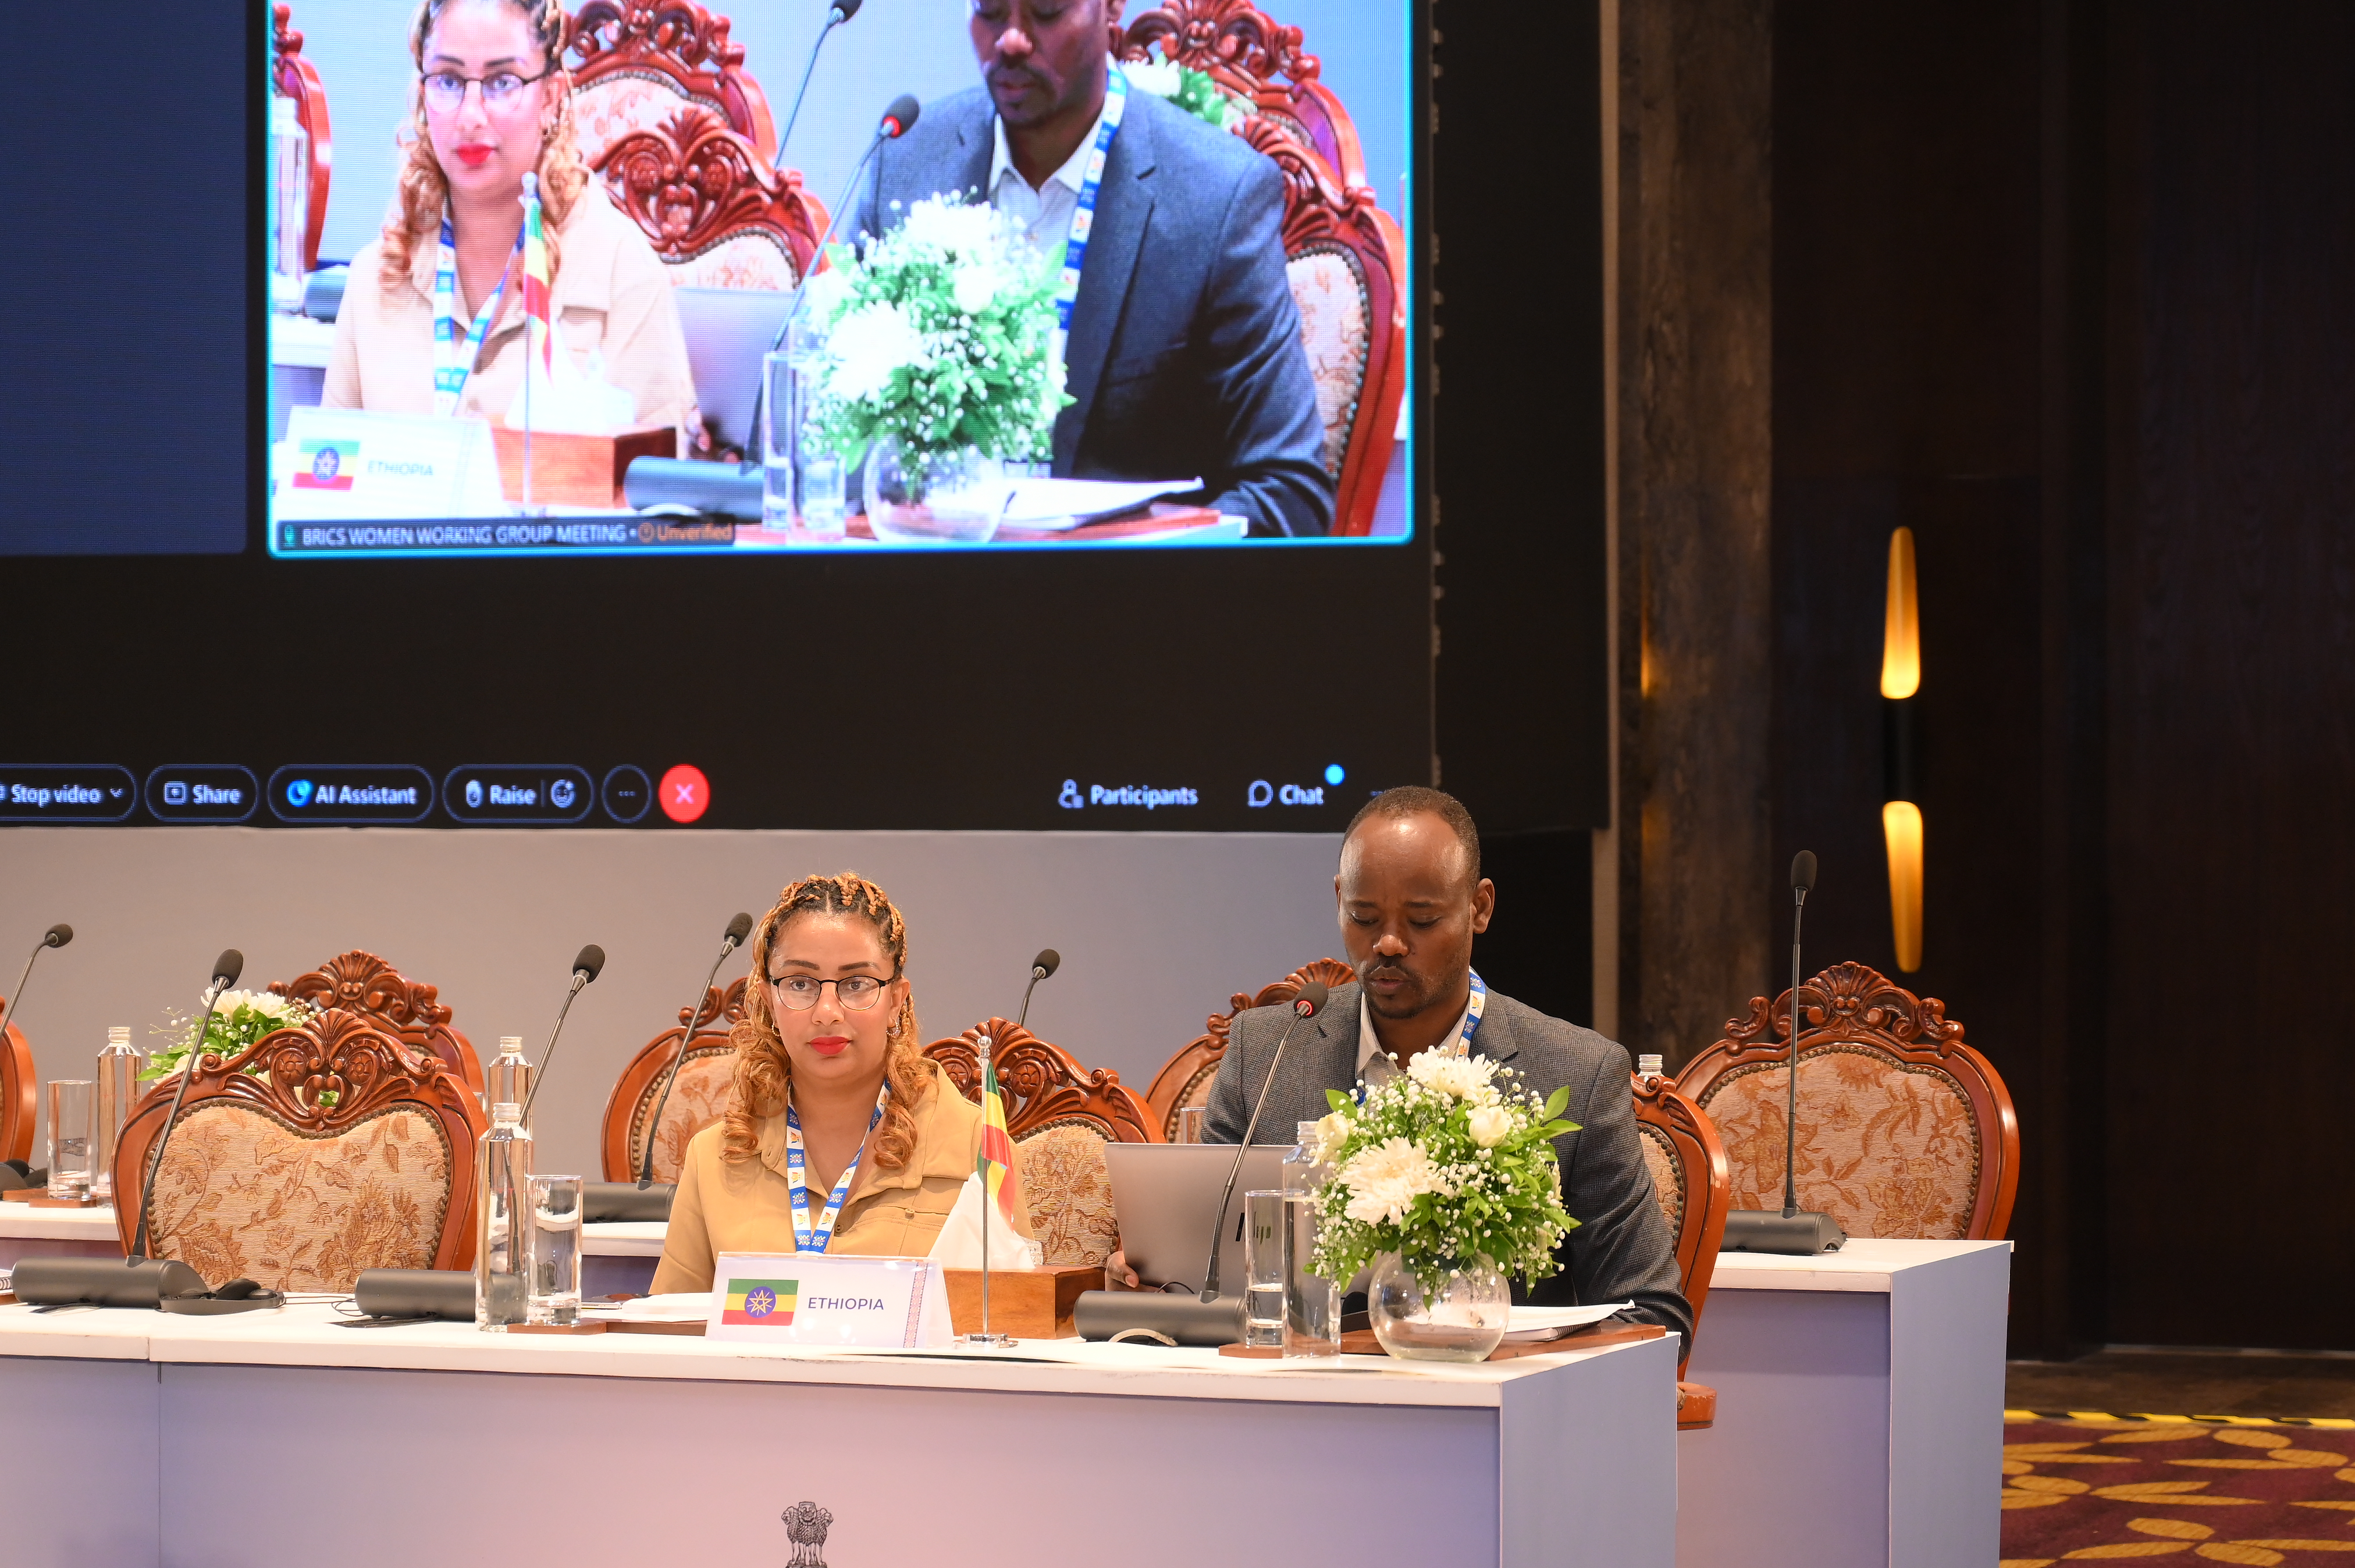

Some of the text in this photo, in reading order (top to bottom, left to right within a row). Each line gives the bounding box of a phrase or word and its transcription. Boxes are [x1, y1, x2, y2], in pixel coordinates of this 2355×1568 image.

[368, 461, 434, 476] ETHIOPIA
[303, 527, 347, 546] BRICS
[349, 527, 413, 546] WOMEN
[416, 526, 493, 544] WORKING
[496, 525, 553, 544] GROUP
[556, 525, 627, 543] MEETING
[11, 783, 102, 808] Stop video
[192, 785, 242, 804] Share
[315, 785, 417, 805] AI Assistant
[489, 785, 537, 805] Raise
[1090, 785, 1199, 810] Participants
[1280, 785, 1324, 805] Chat
[808, 1297, 884, 1311] ETHIOPIA
